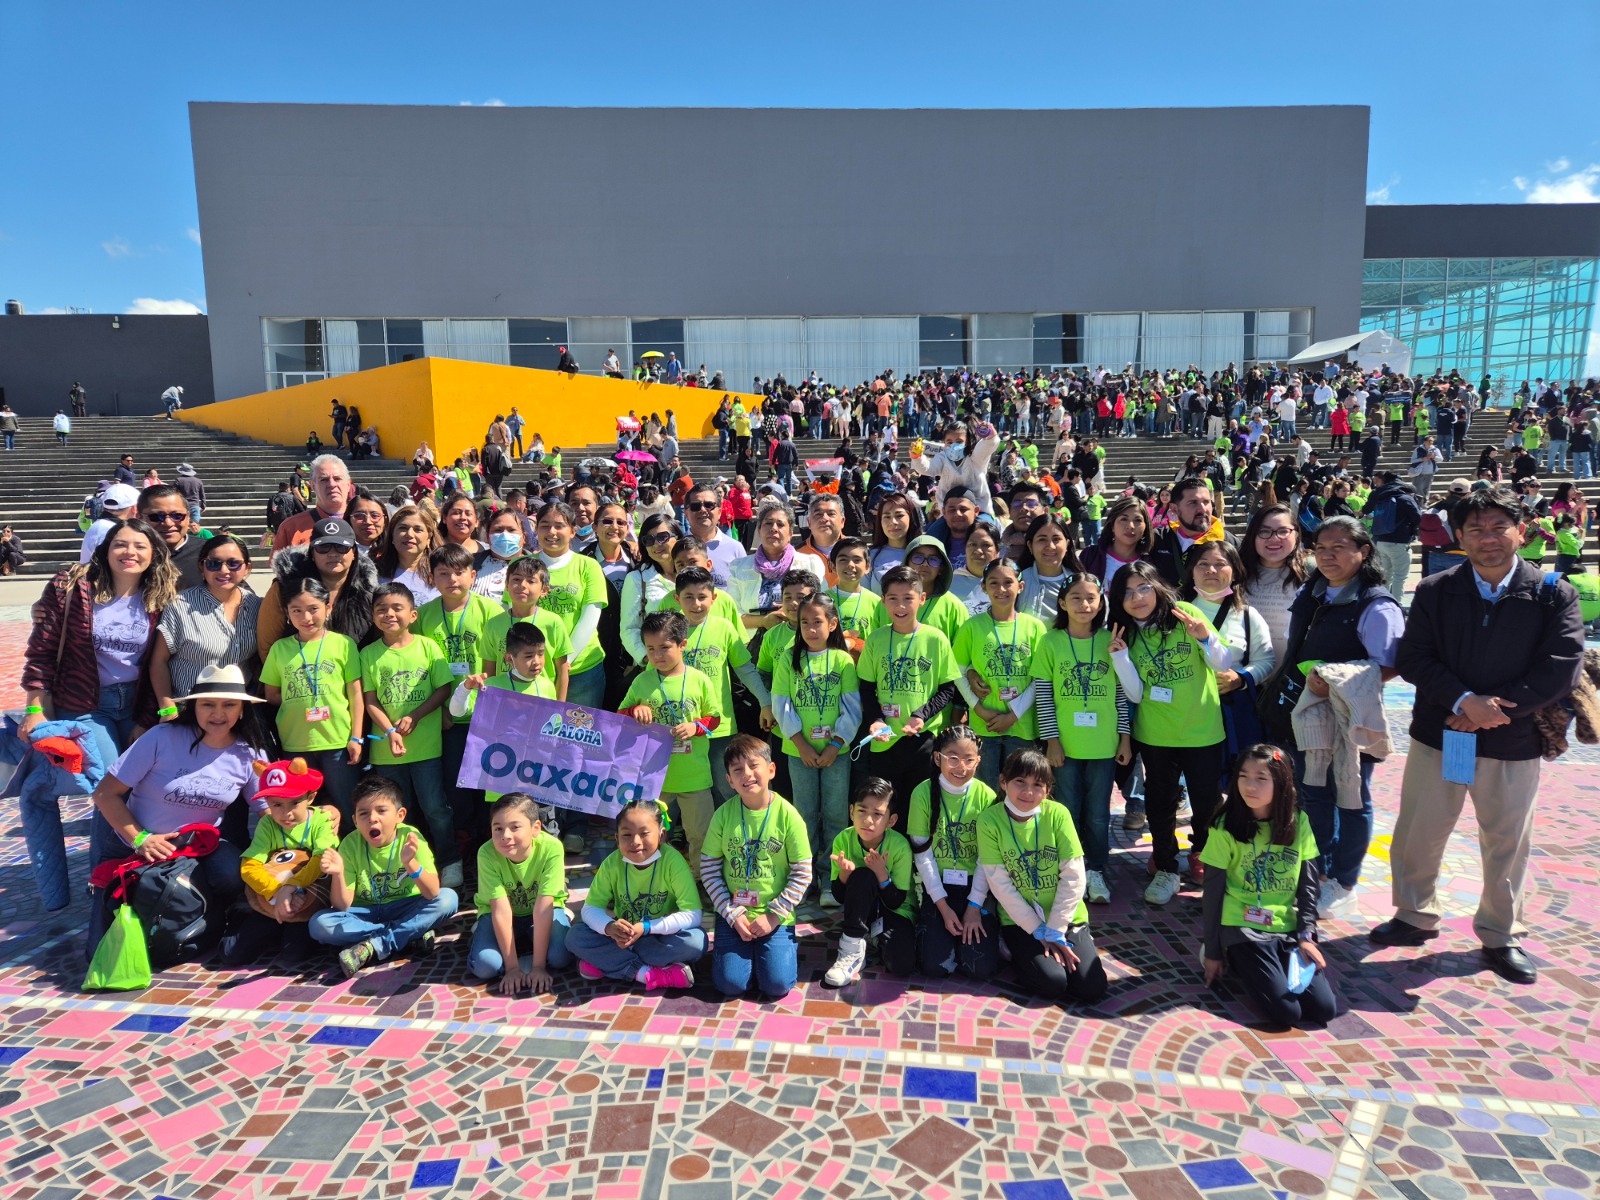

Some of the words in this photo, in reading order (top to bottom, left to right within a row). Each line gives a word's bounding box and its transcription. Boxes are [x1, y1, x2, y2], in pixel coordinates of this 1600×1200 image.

[1072, 684, 1107, 696] ALOHA
[804, 695, 837, 707] ALOHA
[557, 723, 603, 747] ALOHA
[269, 774, 283, 784] M
[481, 743, 643, 806] Oaxaca
[1020, 873, 1058, 890] ALOHA
